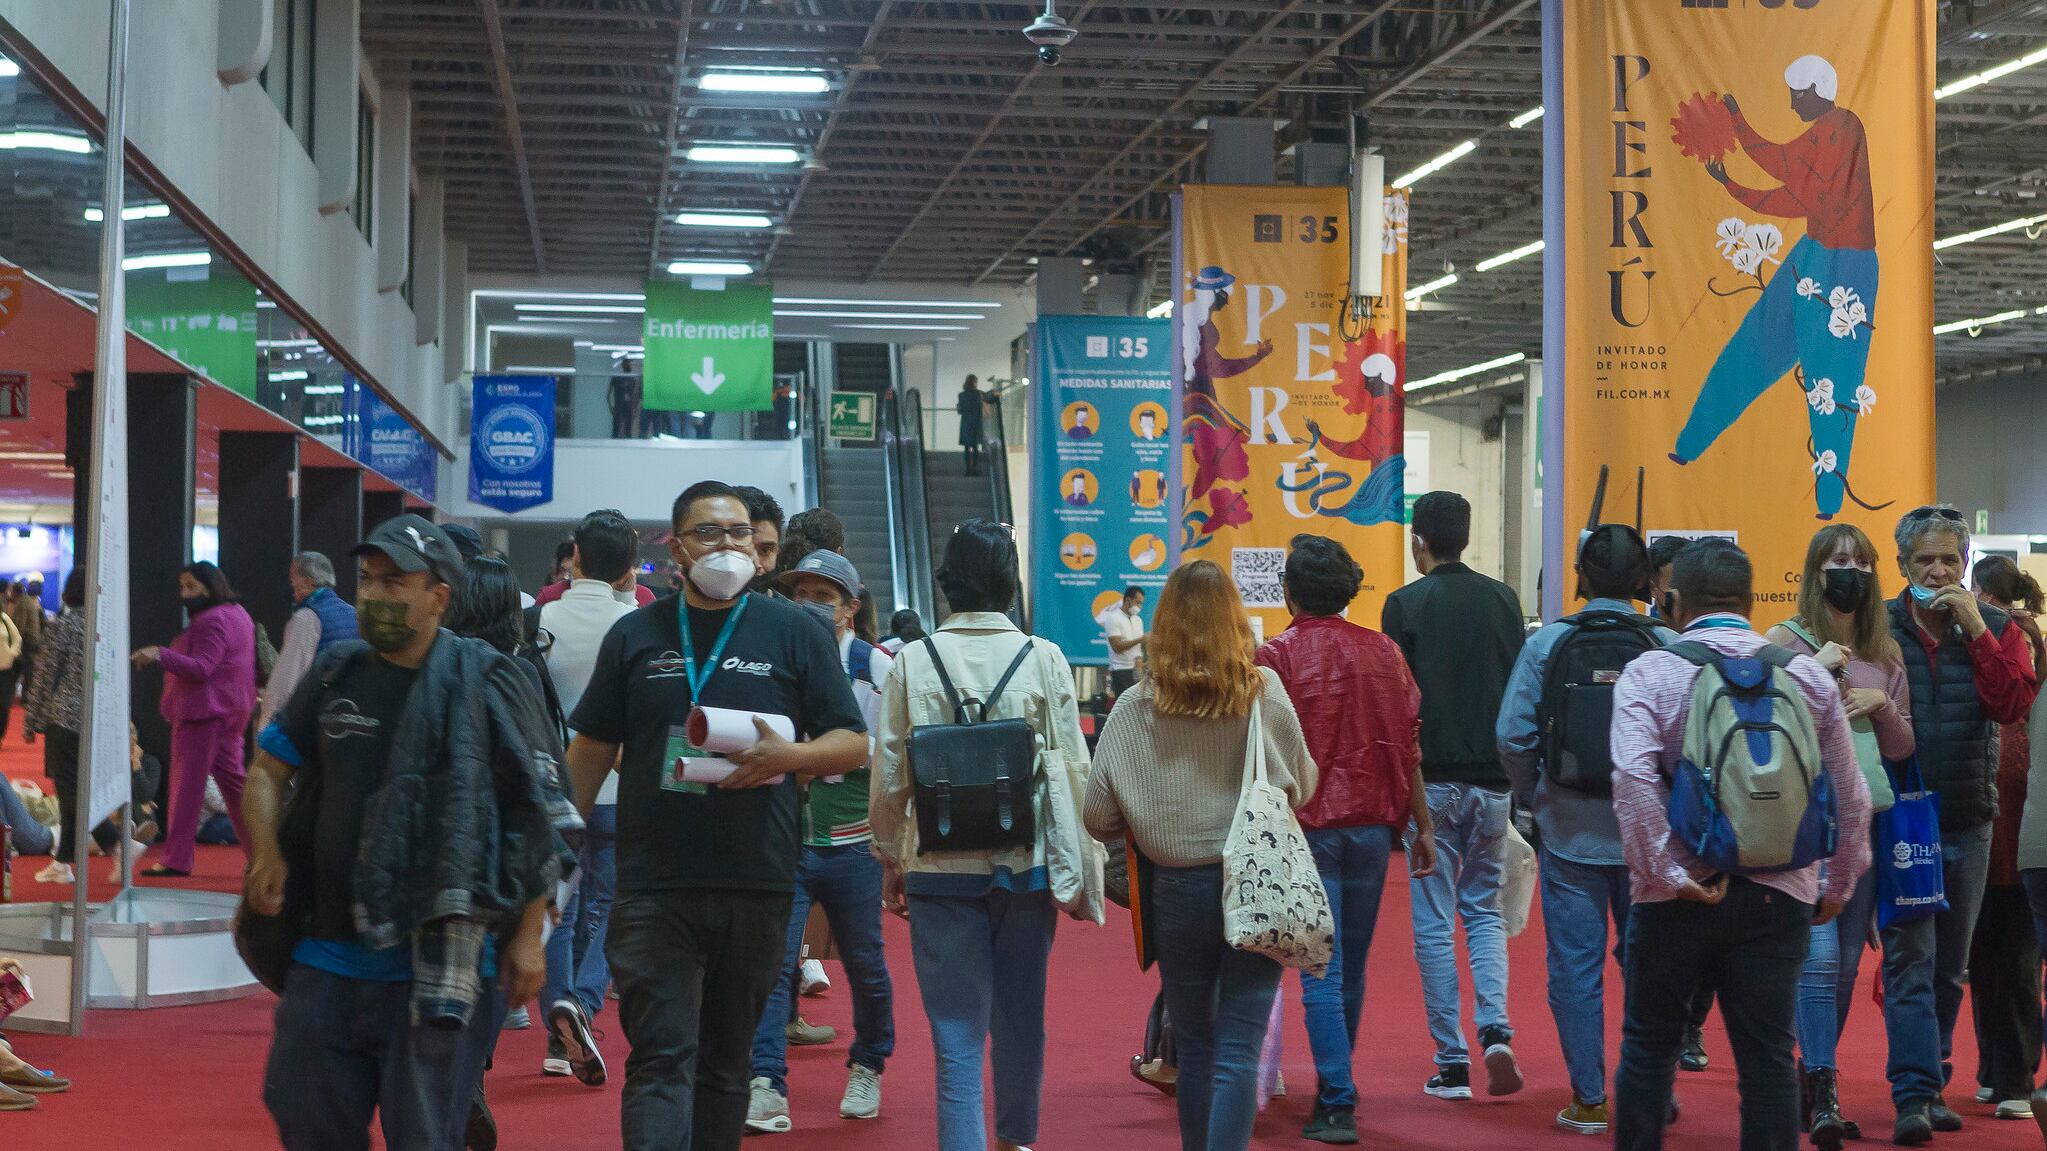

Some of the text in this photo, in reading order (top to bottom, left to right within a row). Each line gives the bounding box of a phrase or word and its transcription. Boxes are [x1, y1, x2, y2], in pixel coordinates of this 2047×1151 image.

[1607, 54, 1656, 328] PERÚ
[1298, 215, 1338, 243] 35
[647, 317, 770, 340] Enfermería
[1120, 337, 1149, 358] 35
[1597, 345, 1667, 356] INVITADO
[1596, 361, 1668, 371] DE HONOR
[1060, 378, 1172, 390] MEDIDAS SANITARIAS
[1596, 389, 1671, 400] FIL.COM.MX
[492, 431, 535, 443] GBAC
[482, 480, 542, 489] Con nosotros
[509, 489, 543, 500] seguro
[1752, 592, 1799, 602] nuestr
